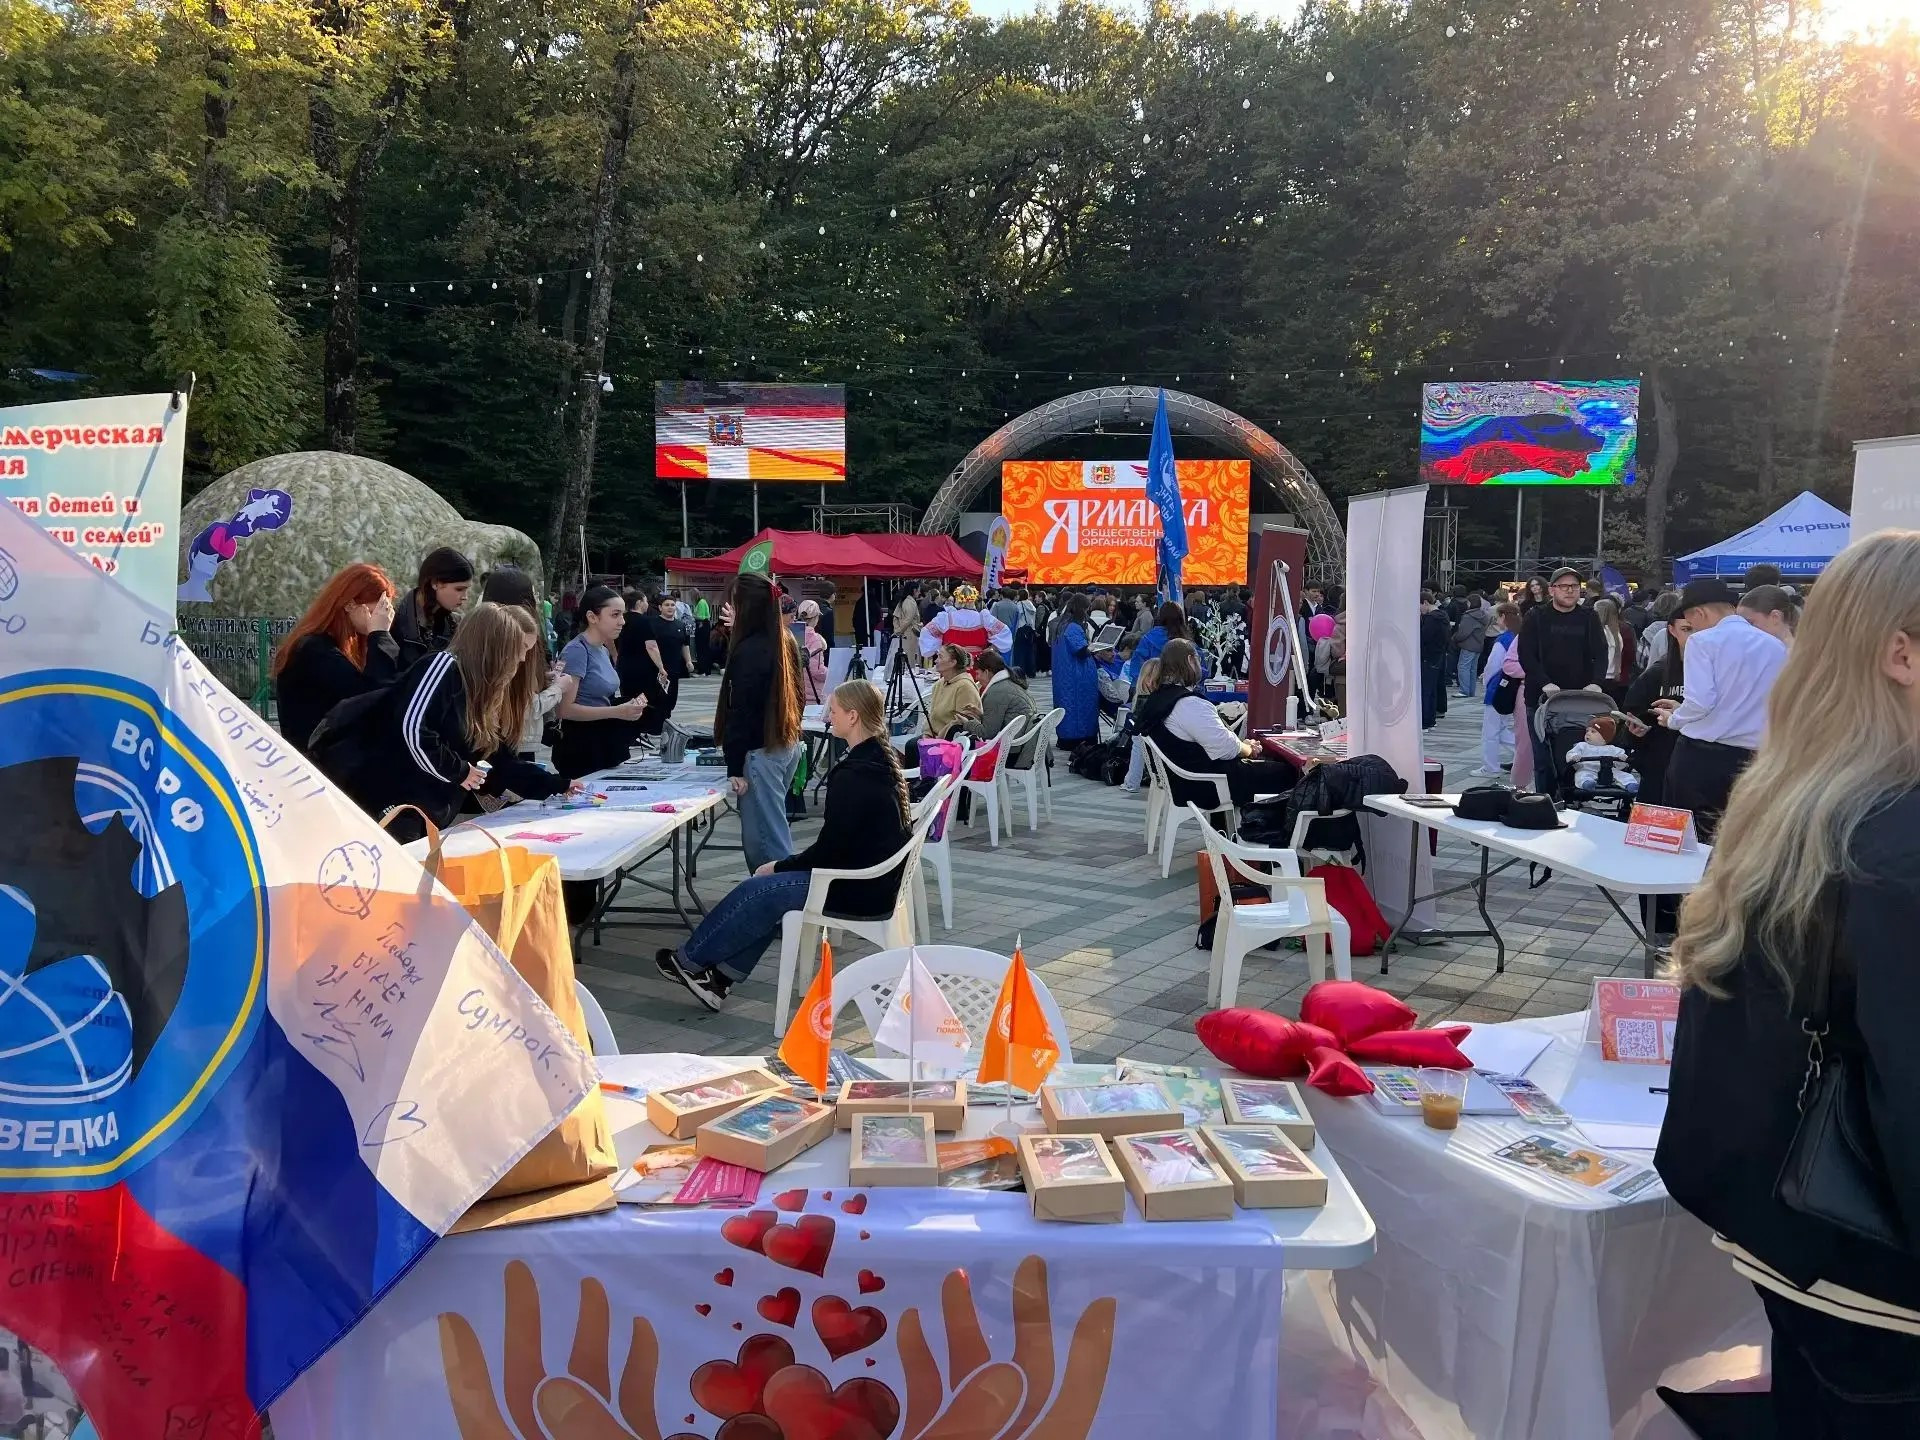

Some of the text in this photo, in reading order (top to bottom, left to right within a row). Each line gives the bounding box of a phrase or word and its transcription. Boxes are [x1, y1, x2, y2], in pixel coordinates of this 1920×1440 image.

[0, 425, 164, 450] мерческая
[49, 496, 114, 513] детей
[126, 500, 138, 512] и
[1041, 499, 1209, 554] ЯРМАА
[1081, 528, 1165, 538] ОБЩЕСТВЕНН
[1081, 538, 1156, 549] ОРГАНИЗАЦ
[155, 767, 206, 833] РФ
